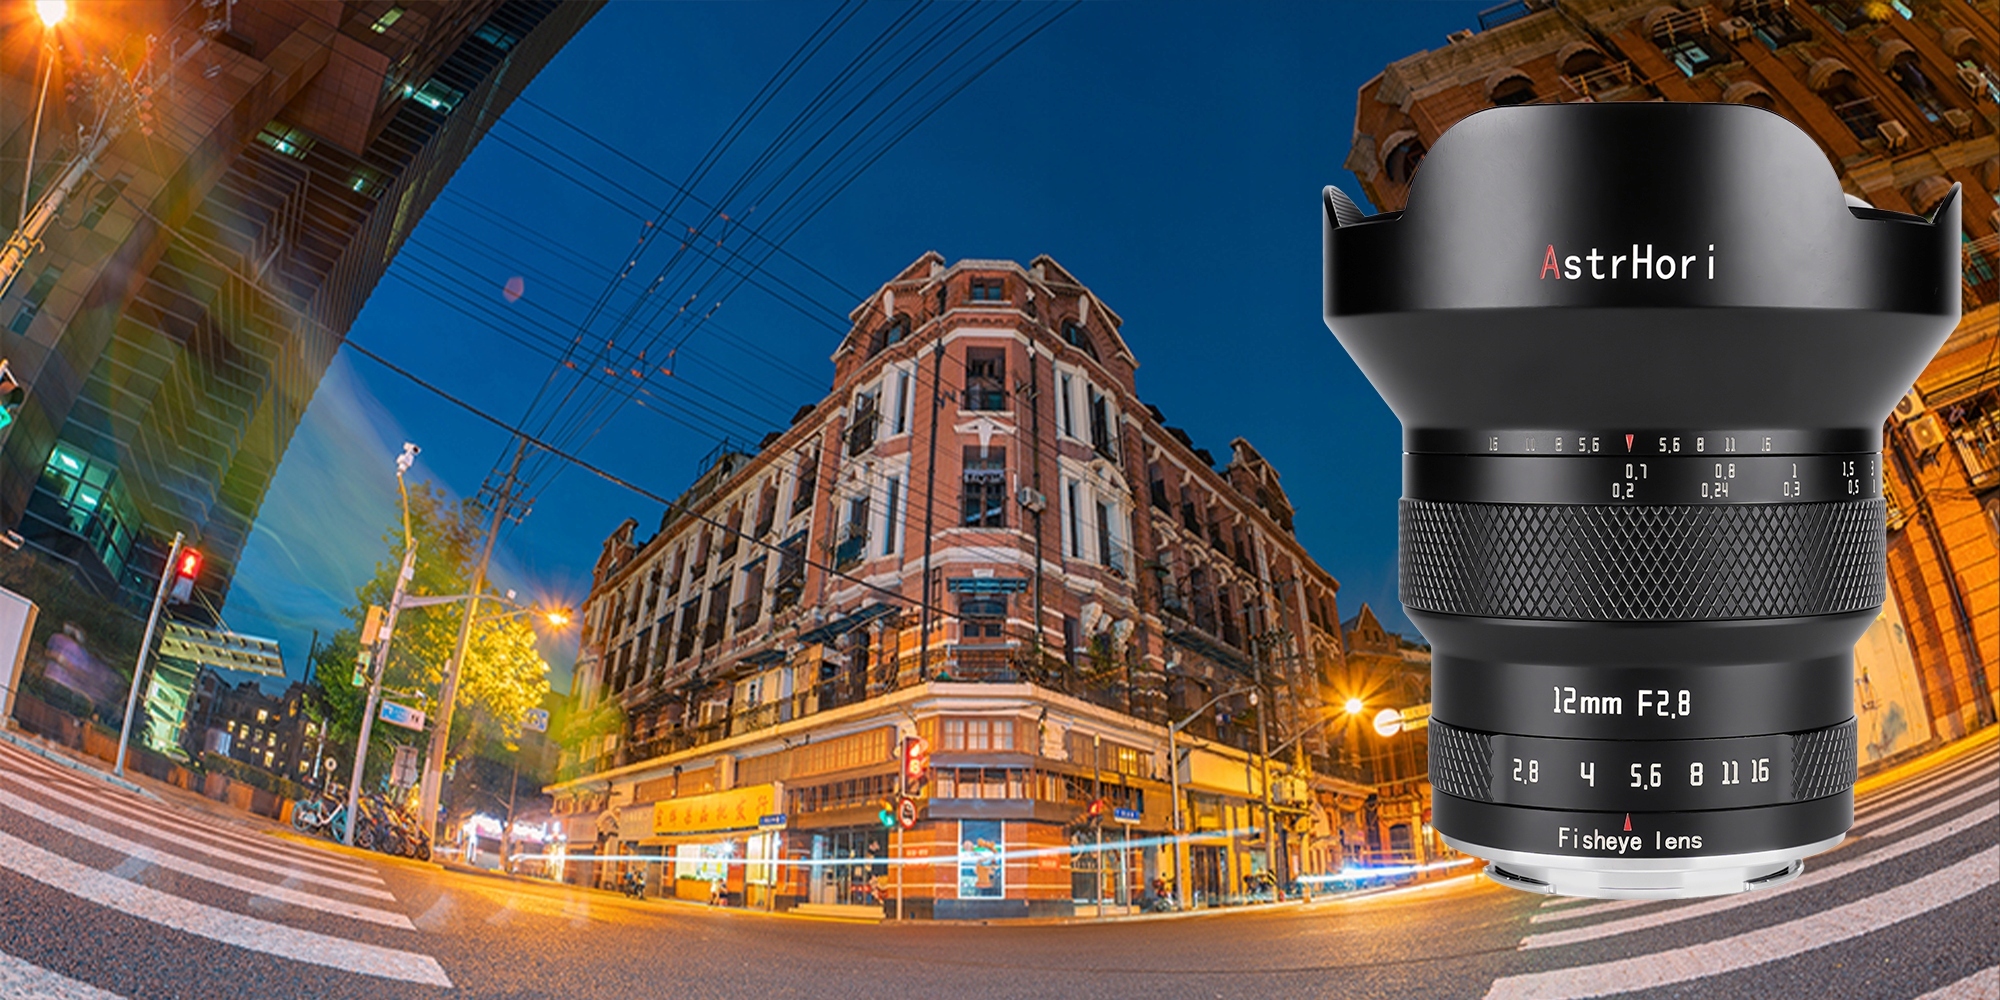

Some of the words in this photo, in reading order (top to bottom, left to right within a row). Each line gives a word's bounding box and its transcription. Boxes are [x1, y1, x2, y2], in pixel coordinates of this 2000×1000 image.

[1540, 243, 1715, 280] AstrHori
[1555, 436, 1563, 452] 8
[1578, 436, 1600, 454] 5.6
[1659, 436, 1681, 454] 5.6
[1696, 436, 1705, 453] 8
[1724, 436, 1736, 452] 11
[1761, 436, 1772, 452] 16
[1625, 463, 1647, 481] 0.7
[1715, 463, 1736, 480] 0.8
[1792, 463, 1798, 479] 1
[1842, 460, 1855, 478] 1.5
[1870, 460, 1875, 477] 3
[1612, 482, 1634, 500] 0.2
[1701, 482, 1729, 499] 0.24
[1783, 481, 1800, 498] 0.3
[1848, 479, 1860, 496] 0.5
[1553, 686, 1623, 716] 12mm
[1637, 689, 1692, 720] F2.8
[1513, 758, 1540, 784] 2.8
[1580, 760, 1596, 788] 4
[1630, 763, 1662, 791] 5.6
[1689, 761, 1704, 787] 8
[1721, 760, 1740, 785] 11
[1751, 757, 1770, 783] 16
[1557, 827, 1642, 855] Fisheye
[1655, 829, 1703, 850] lens
